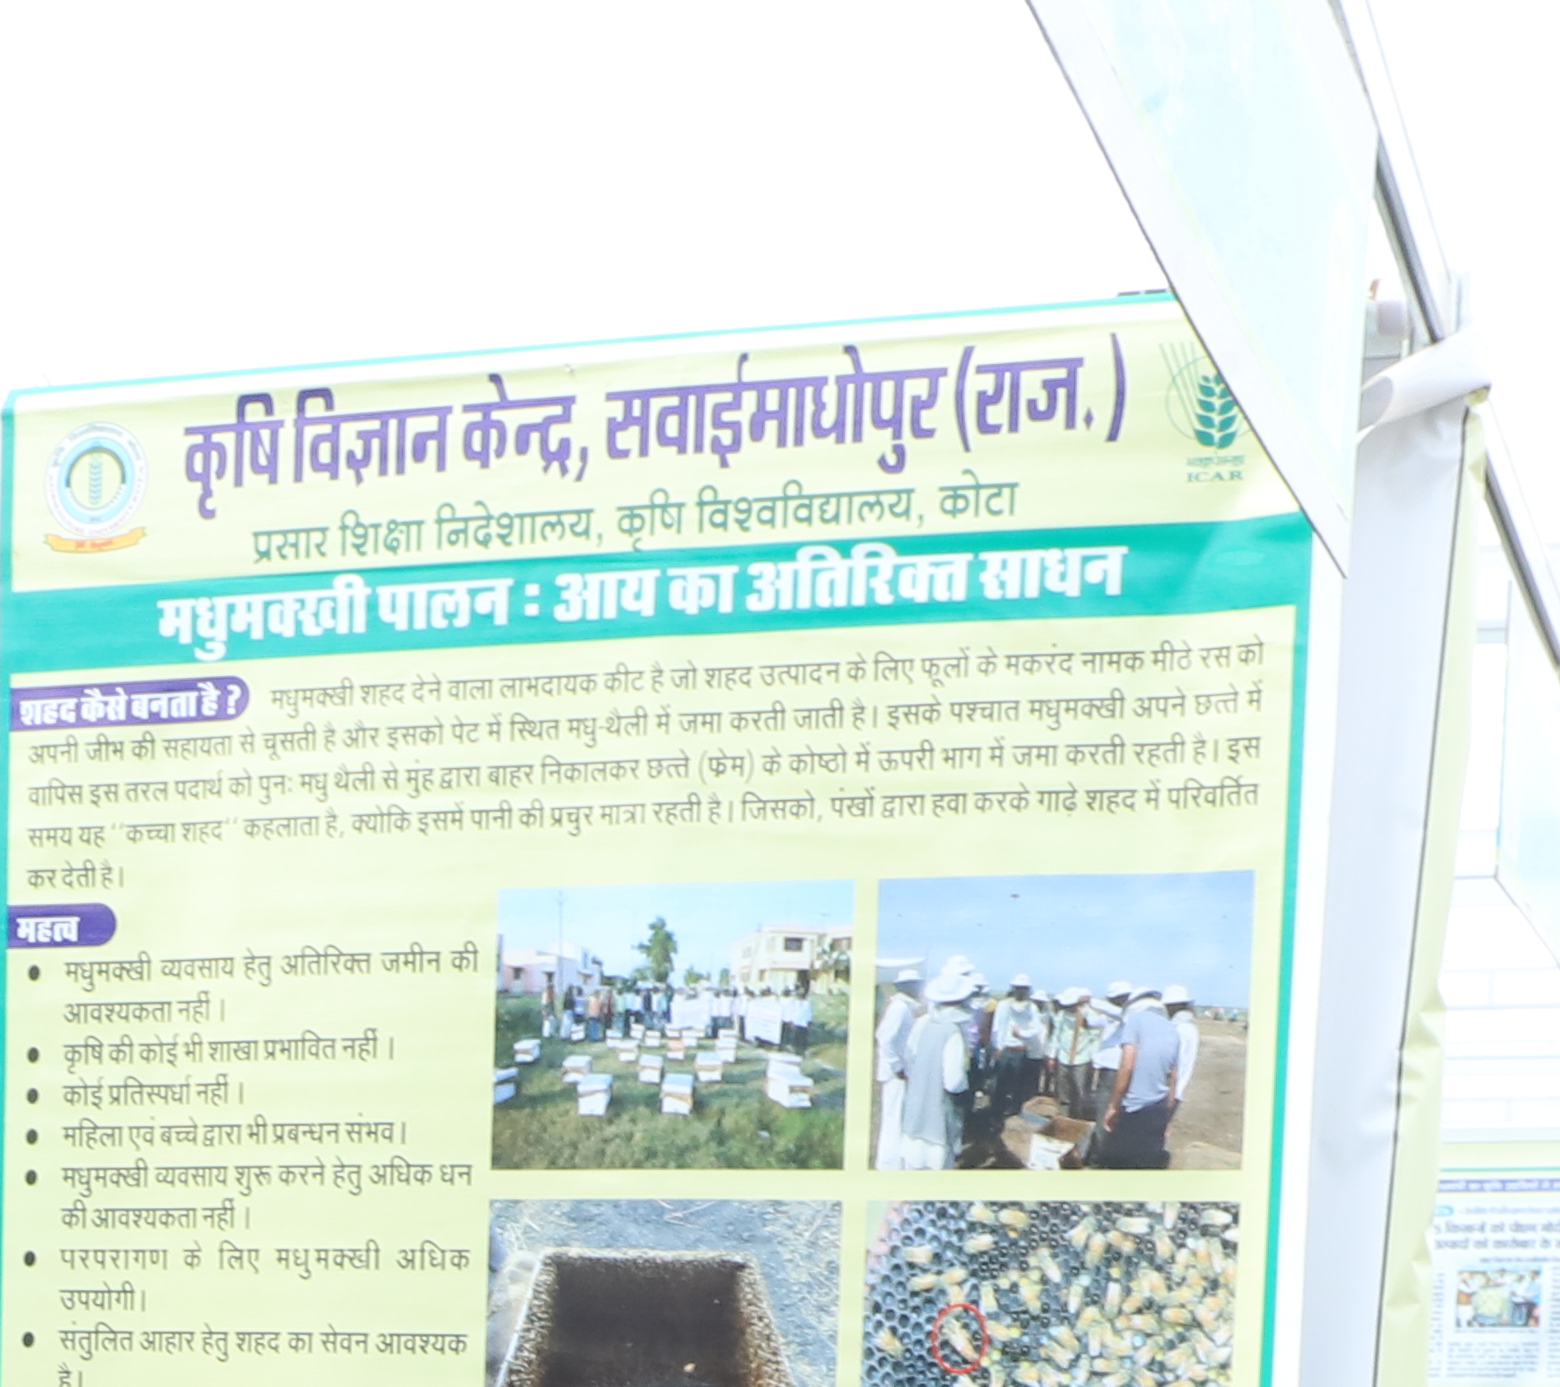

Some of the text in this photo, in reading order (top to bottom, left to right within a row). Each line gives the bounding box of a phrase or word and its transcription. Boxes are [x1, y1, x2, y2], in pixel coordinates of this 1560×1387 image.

[184, 392, 284, 520] कृषि
[294, 387, 453, 486] विज्ञान
[462, 374, 588, 482] केन्द्र,
[605, 348, 948, 475] सवाईमाधोपुर
[954, 333, 1126, 453] (राज.)
[252, 471, 1019, 564] प्रसार शिक्षा निदेशालय, कृषि विश्वविद्यालय, कोटा
[157, 579, 372, 661] मधुमक्खी
[376, 578, 514, 631] पालन
[554, 568, 661, 621] आय
[667, 564, 739, 615] का
[746, 550, 974, 612] अतिरिक्त
[979, 546, 1128, 600] साधन
[19, 698, 78, 726] शहद
[79, 687, 128, 723] कैसे
[130, 691, 199, 720] बनता
[197, 681, 221, 717] है
[16, 916, 80, 943] महत्व
[62, 1113, 406, 1151] महिला एवं बच्चे द्वारा भी प्रबन्धन संभव।
